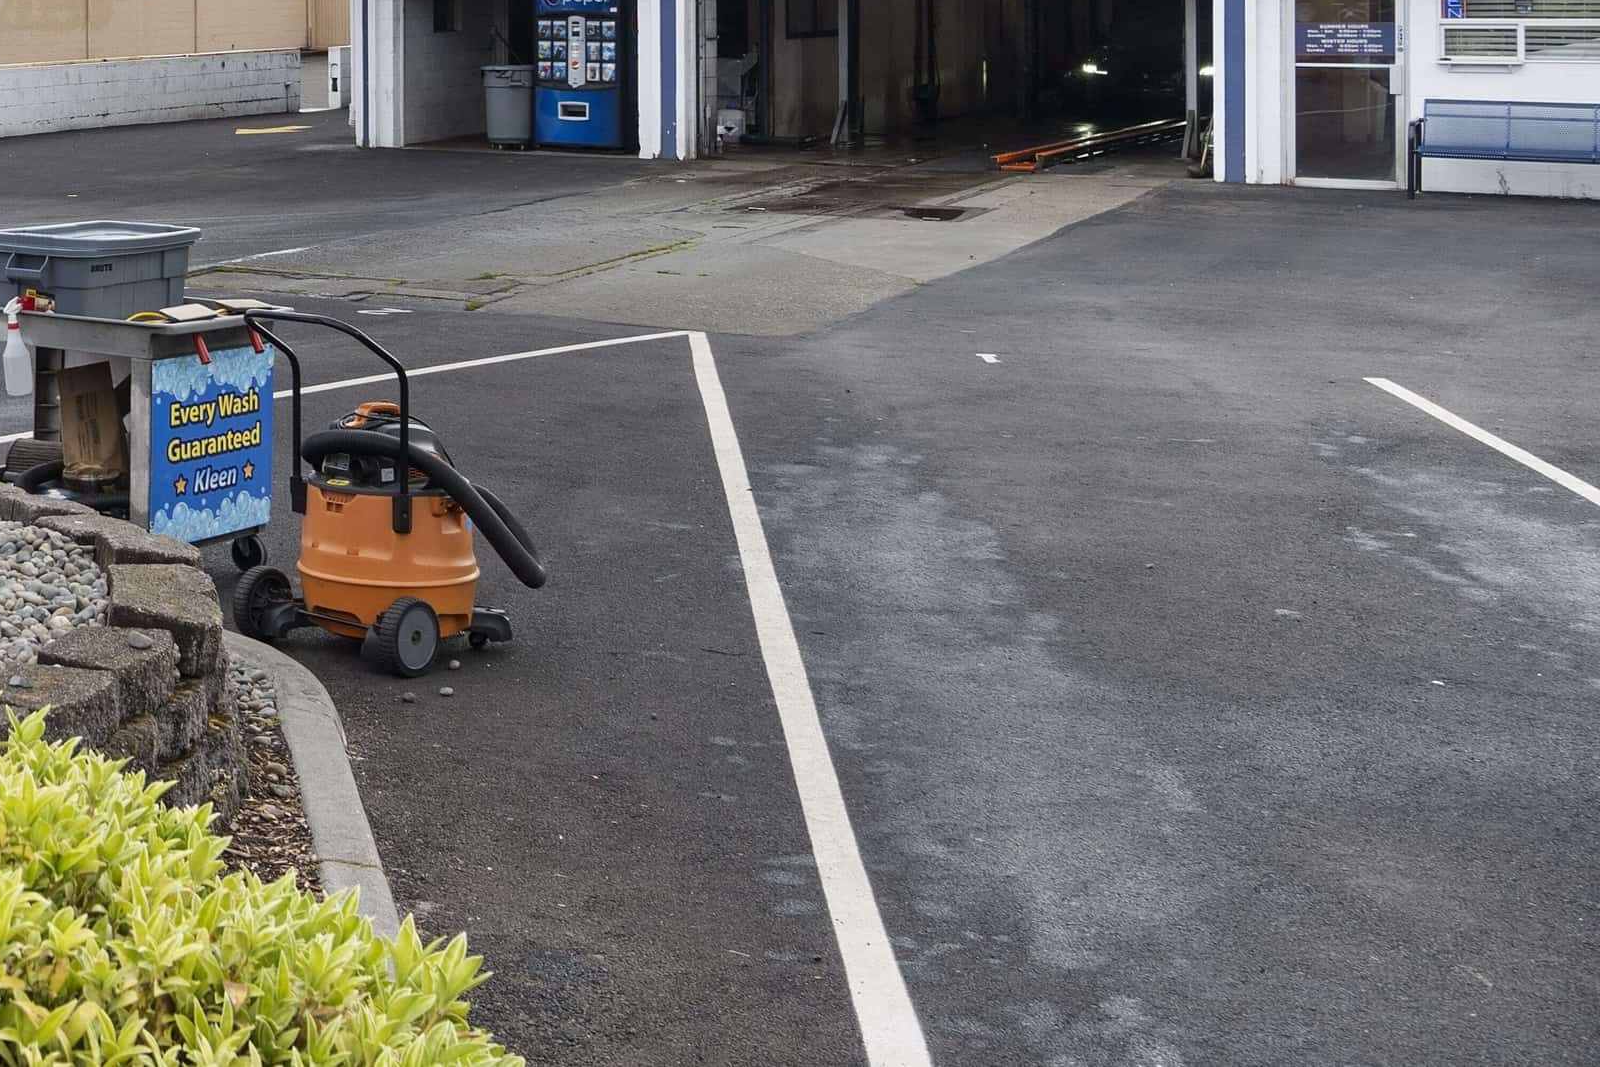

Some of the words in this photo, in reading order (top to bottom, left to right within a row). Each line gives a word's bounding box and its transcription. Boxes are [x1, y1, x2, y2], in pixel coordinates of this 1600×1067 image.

[170, 402, 216, 426] Every
[218, 389, 259, 417] Wash
[167, 421, 261, 462] Guaranteed
[194, 467, 238, 493] Kleen
